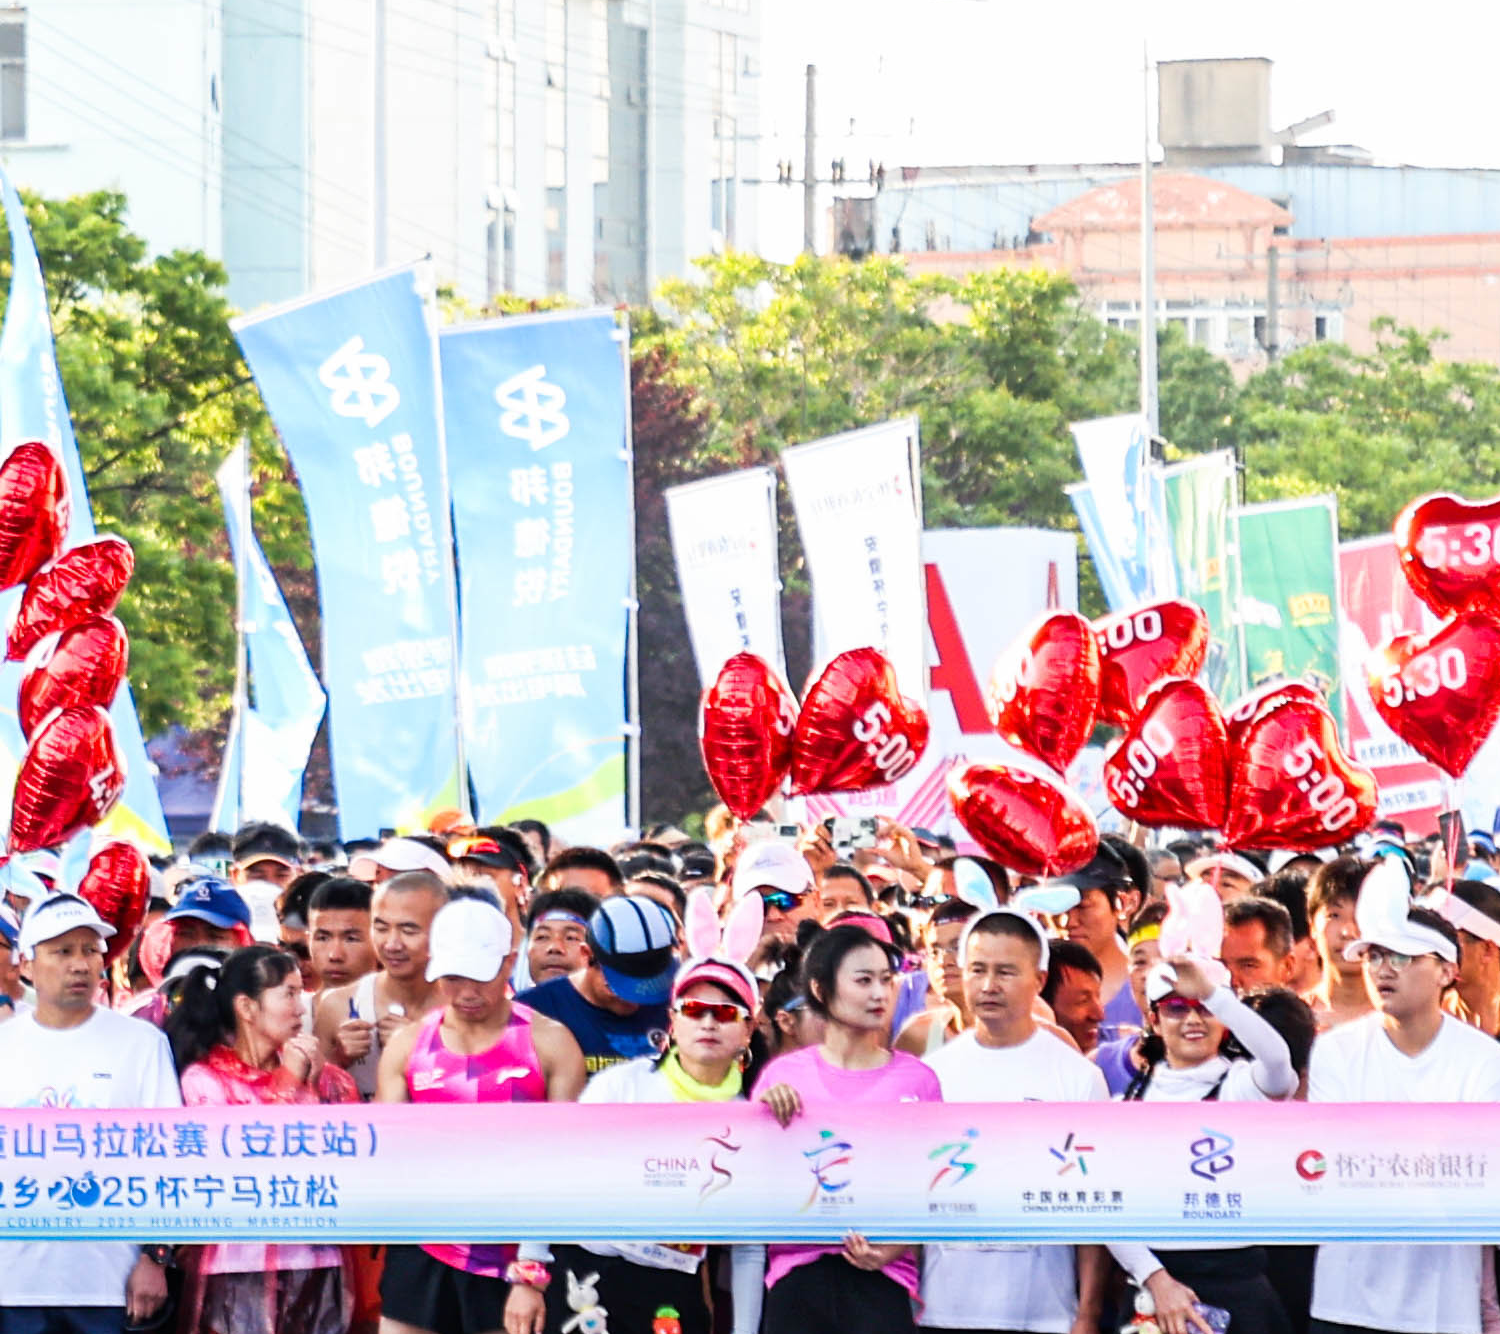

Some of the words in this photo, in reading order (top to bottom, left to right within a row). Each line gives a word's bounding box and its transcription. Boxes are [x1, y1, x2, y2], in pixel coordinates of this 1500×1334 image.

[1097, 610, 1162, 656] :00
[1382, 647, 1467, 707] 5:30
[853, 702, 916, 783] 5:00
[1108, 720, 1175, 808] 5:00
[1283, 738, 1358, 832] 5:00
[644, 1157, 701, 1172] CHINA
[1337, 1152, 1487, 1180] 怀宁农商银行
[1023, 1190, 1124, 1204] 中国体育彩票
[1184, 1193, 1241, 1207] 邦德锐
[7, 1216, 82, 1228] COUNTRY
[99, 1216, 136, 1228] 2025
[150, 1217, 233, 1228] HUAINING
[248, 1217, 339, 1228] MARATHON
[1183, 1210, 1241, 1220] BOUNDARY
